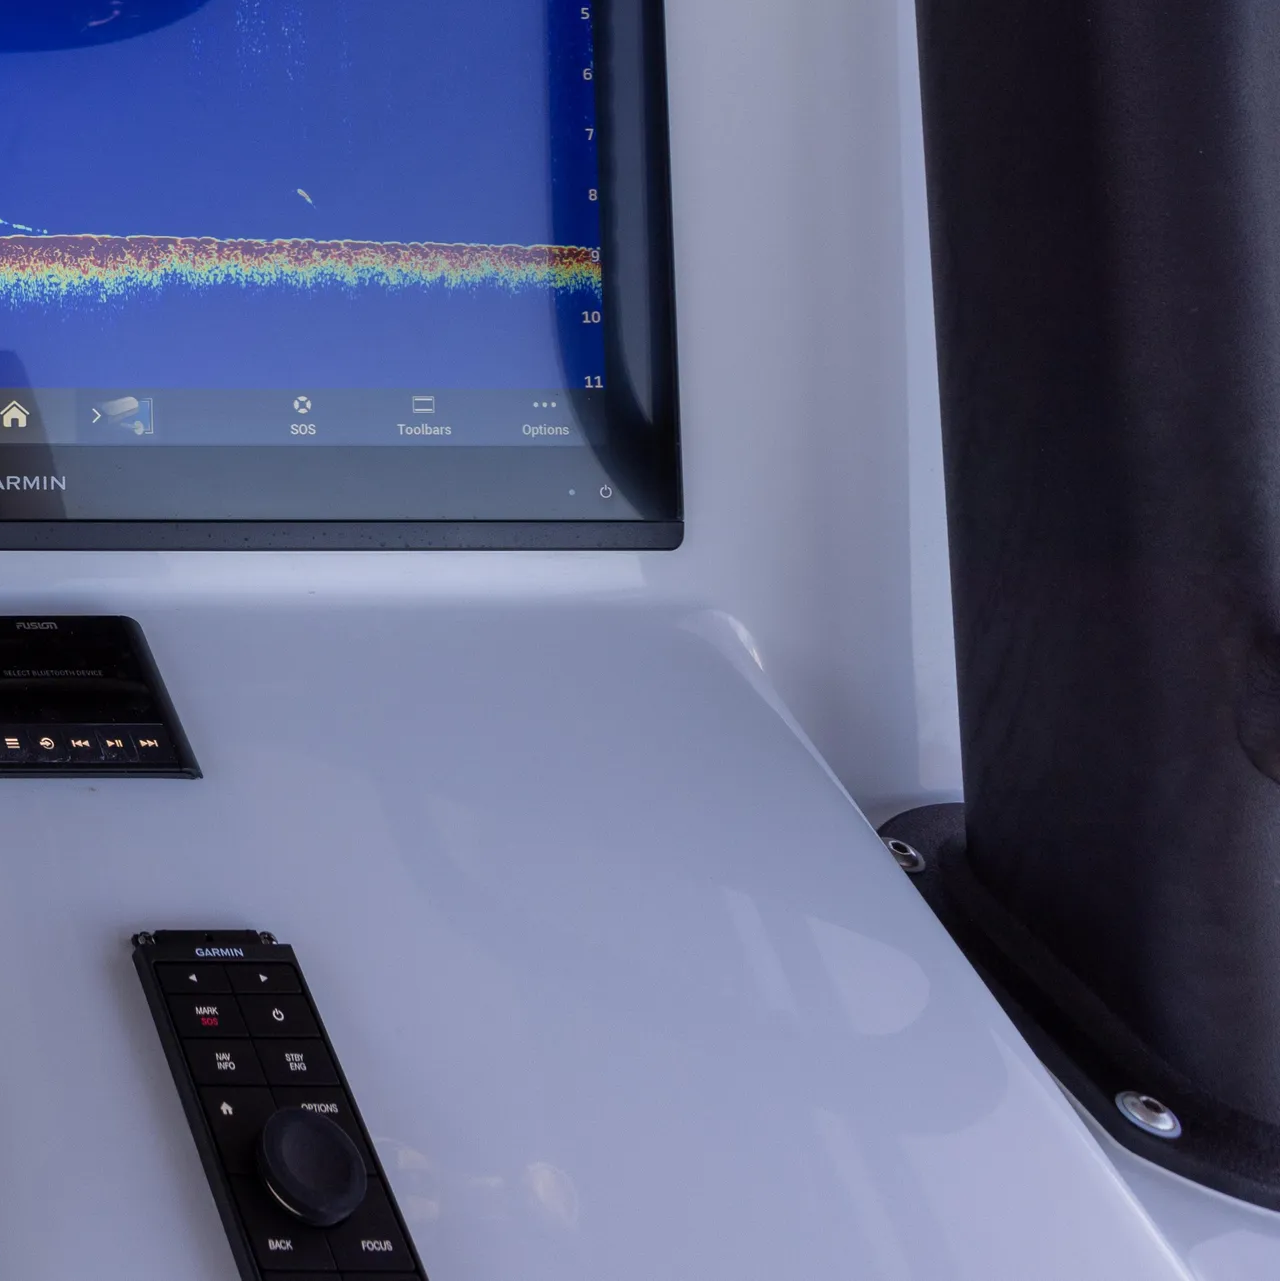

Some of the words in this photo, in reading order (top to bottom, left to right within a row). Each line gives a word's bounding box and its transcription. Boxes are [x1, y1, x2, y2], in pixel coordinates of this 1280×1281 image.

[580, 7, 590, 19] 5
[582, 68, 593, 80] 6
[585, 129, 594, 140] 7
[588, 189, 598, 201] 8
[590, 250, 601, 263] 9
[581, 311, 601, 323] 10
[584, 376, 604, 388] 11
[290, 424, 316, 436] SOS
[397, 424, 452, 436] Toolbars
[522, 424, 569, 438] Options
[16, 622, 58, 630] FUSION
[195, 948, 244, 957] GARMIN
[195, 1007, 218, 1015] MARK
[200, 1018, 218, 1026] SOS
[215, 1053, 230, 1061] NAV
[285, 1053, 303, 1062] STBY
[217, 1062, 235, 1070] INFO
[290, 1063, 306, 1071] ENG
[268, 1239, 293, 1250] BACK
[361, 1240, 393, 1251] FOCUS
